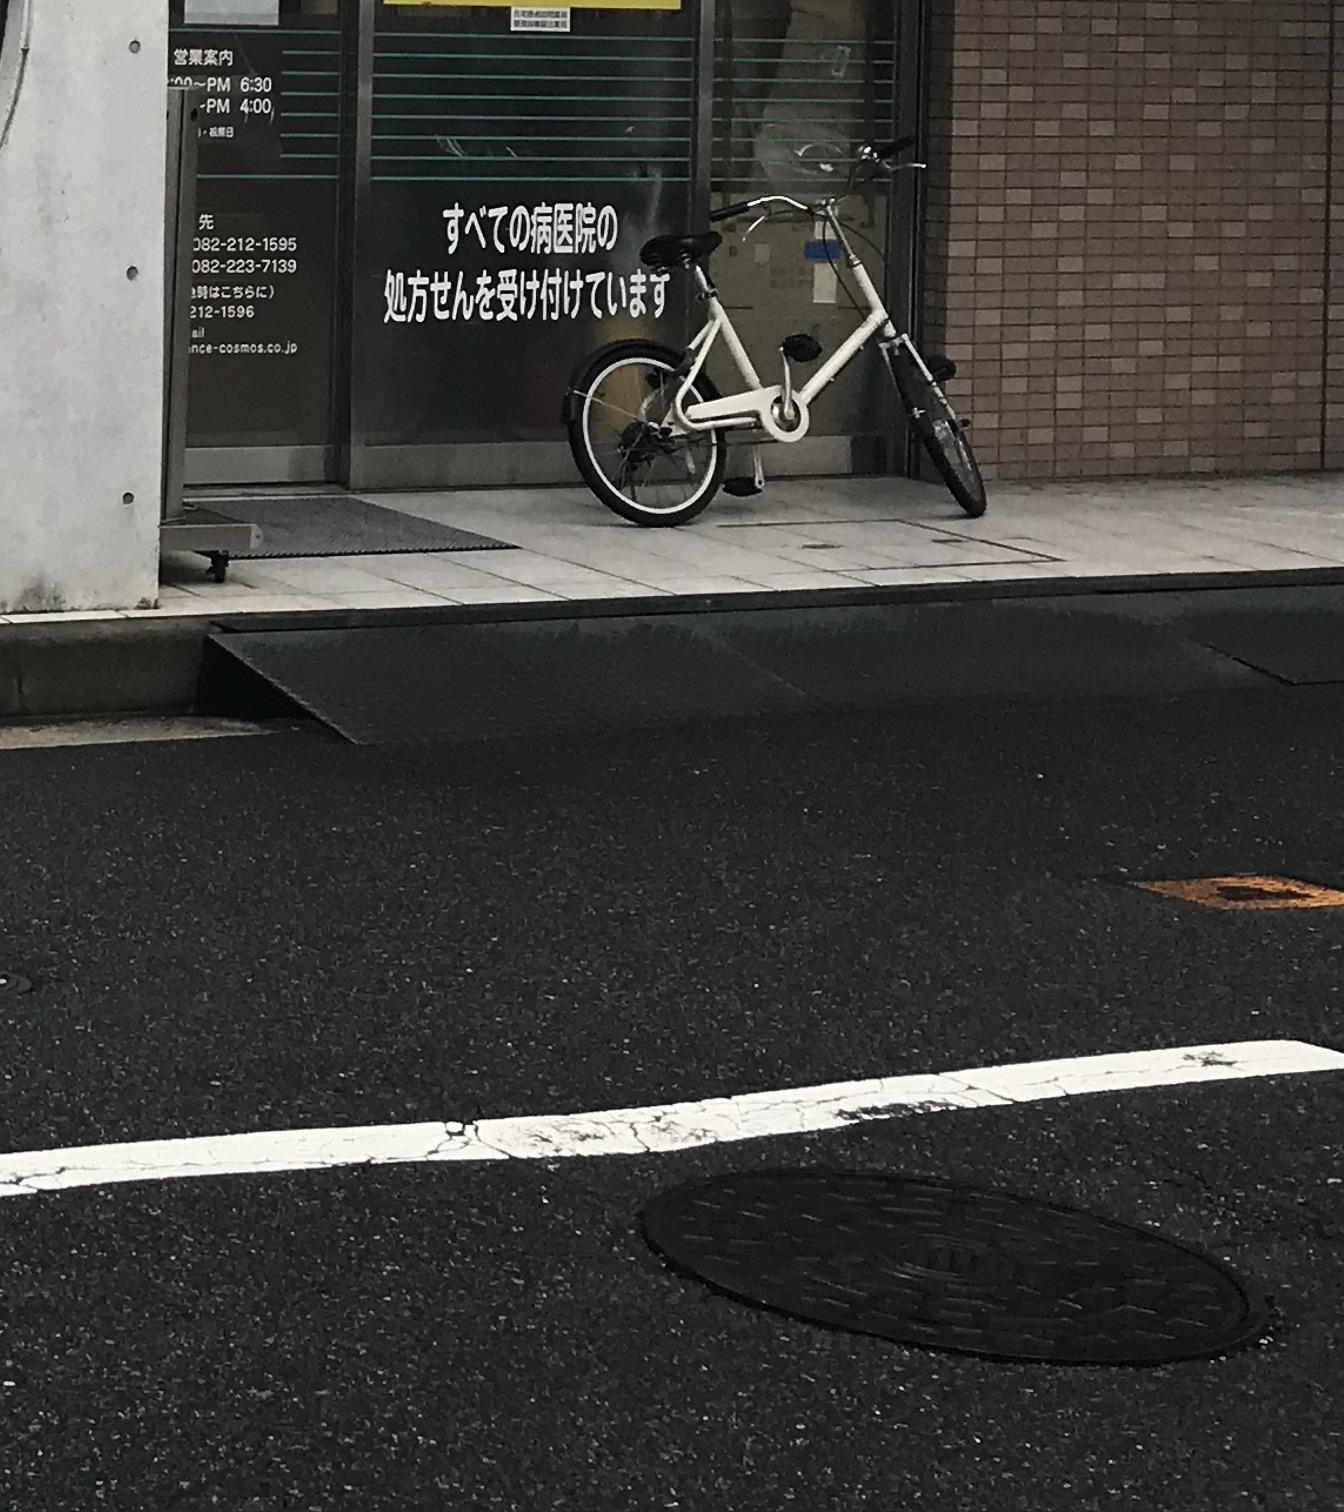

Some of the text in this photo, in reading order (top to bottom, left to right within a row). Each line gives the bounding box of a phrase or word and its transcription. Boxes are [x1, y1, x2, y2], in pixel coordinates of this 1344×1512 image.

[173, 48, 234, 67] 営業案内
[240, 76, 273, 93] 6:30
[240, 98, 272, 114] 4:00
[442, 202, 618, 255] すべての病医院の
[193, 236, 297, 252] 082-212-1595
[192, 259, 297, 274] 082-223-7139
[383, 268, 670, 323] 処方せんを受け付けています
[190, 305, 255, 319] 212-1596
